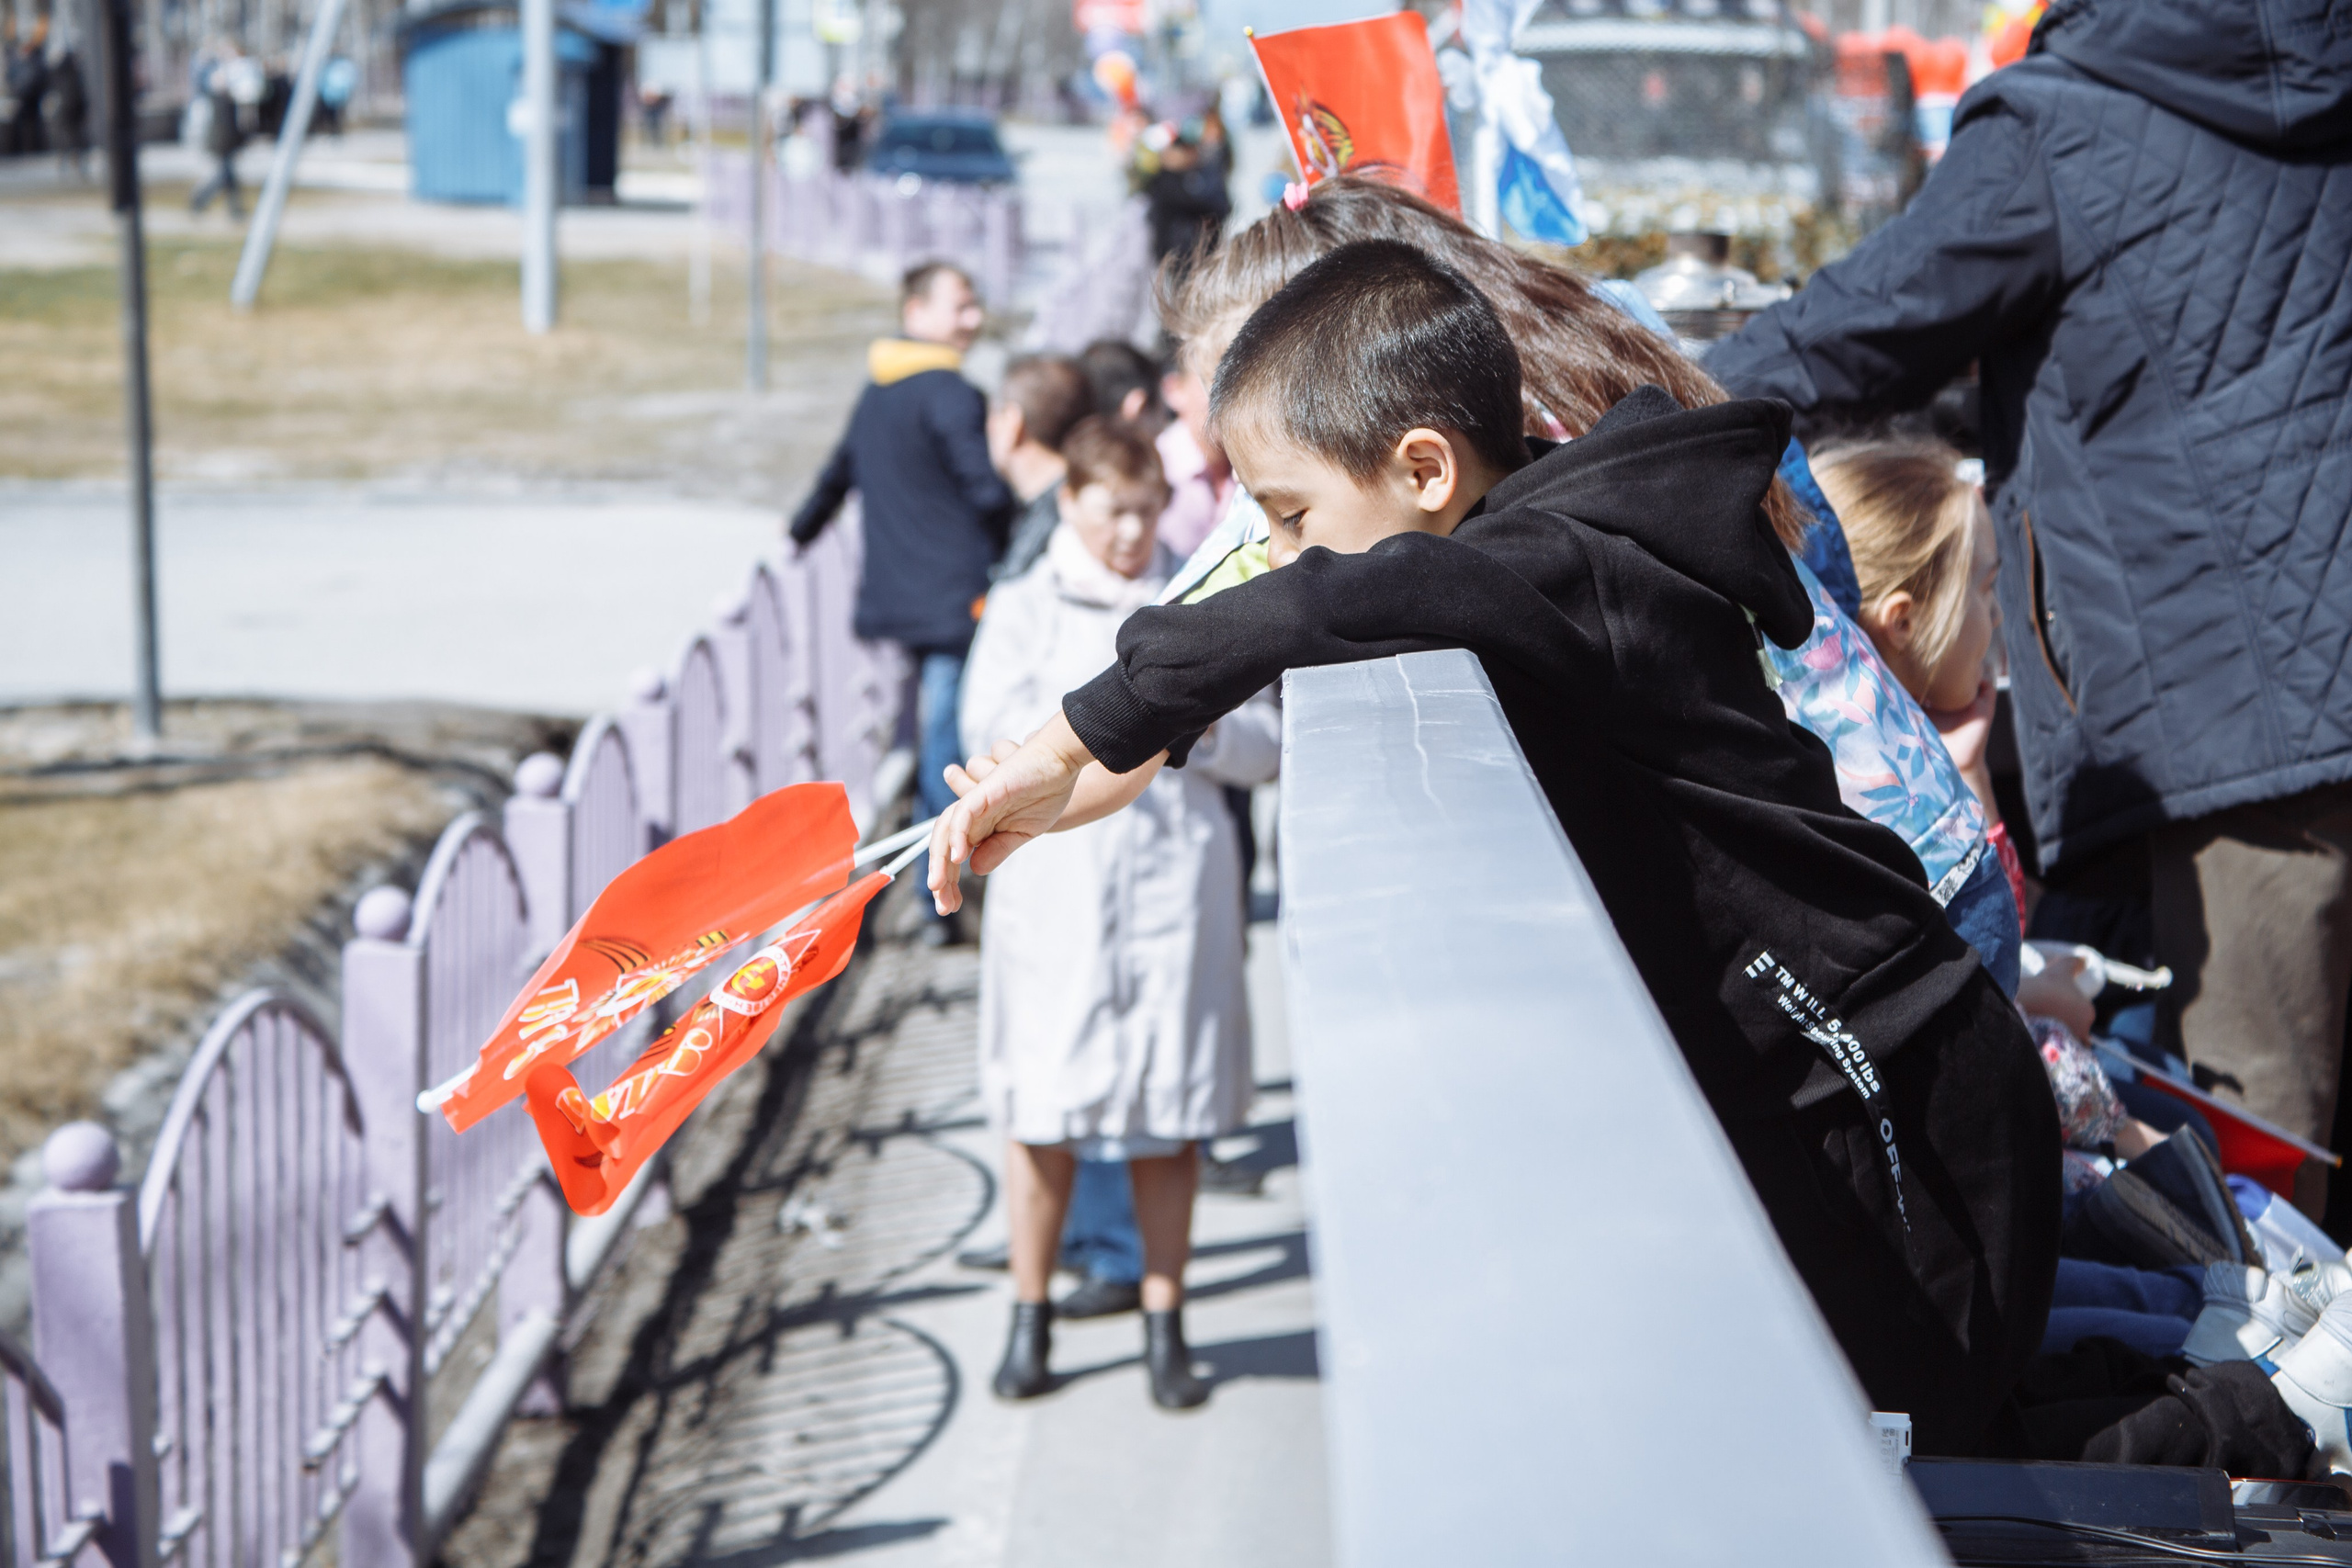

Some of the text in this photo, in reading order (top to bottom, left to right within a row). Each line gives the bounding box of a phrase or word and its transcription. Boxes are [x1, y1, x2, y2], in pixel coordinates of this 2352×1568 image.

[1778, 993, 1871, 1100] Weight Securing System
[1859, 1061, 1881, 1093] lbs
